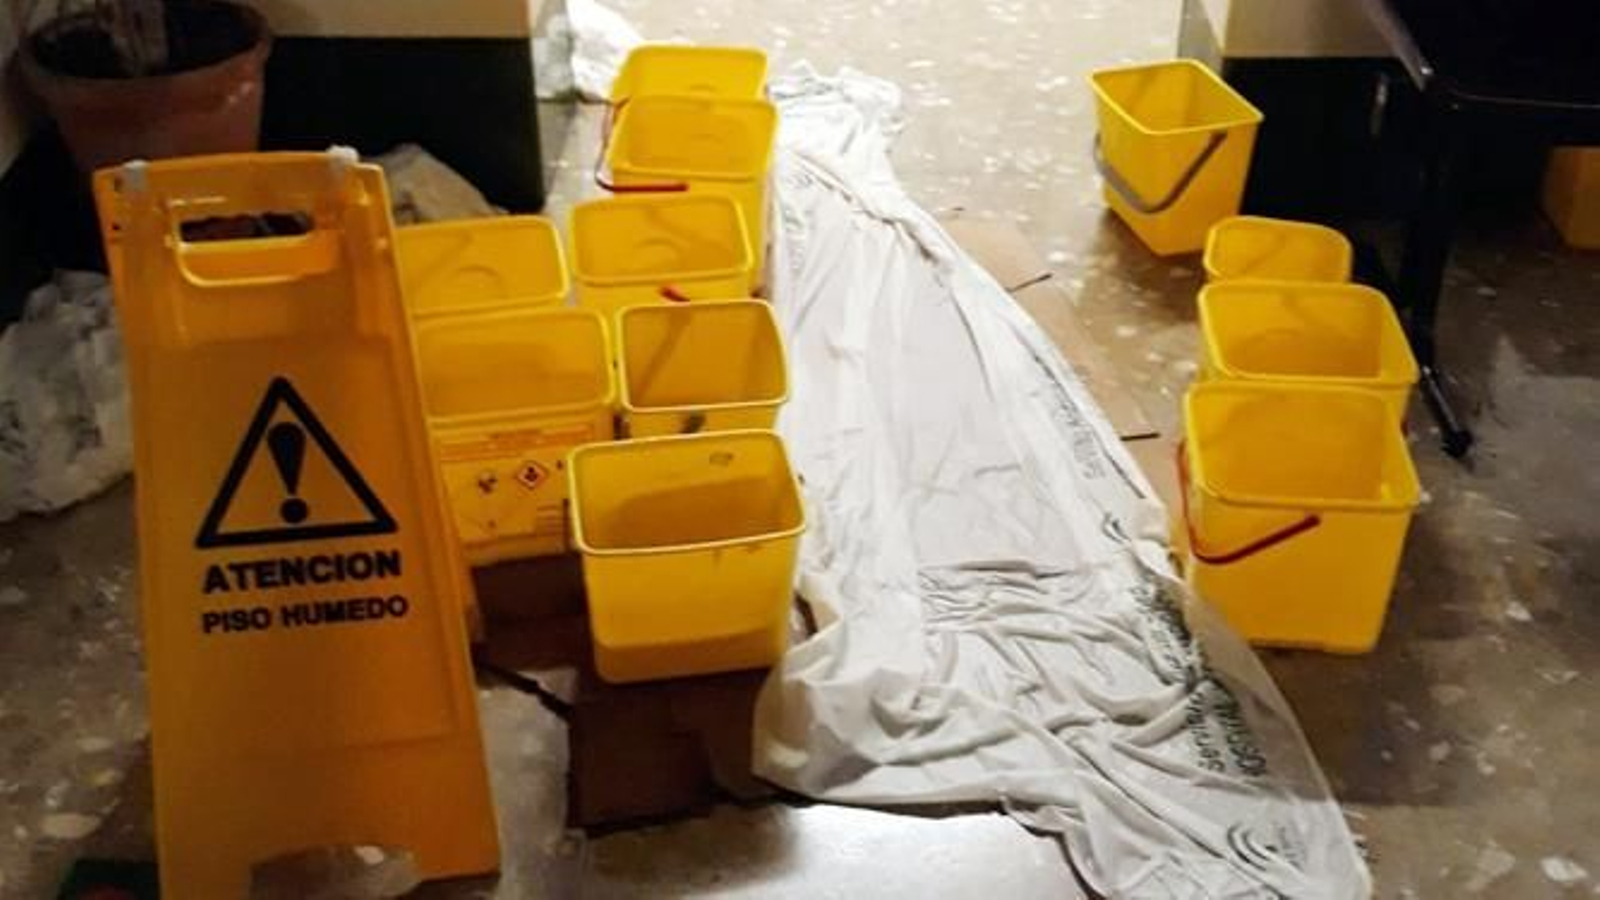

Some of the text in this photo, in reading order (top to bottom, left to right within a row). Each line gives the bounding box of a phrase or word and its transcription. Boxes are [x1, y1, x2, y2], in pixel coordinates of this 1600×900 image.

[203, 550, 401, 593] ATENCION
[203, 595, 408, 633] PISO HUMEDO
